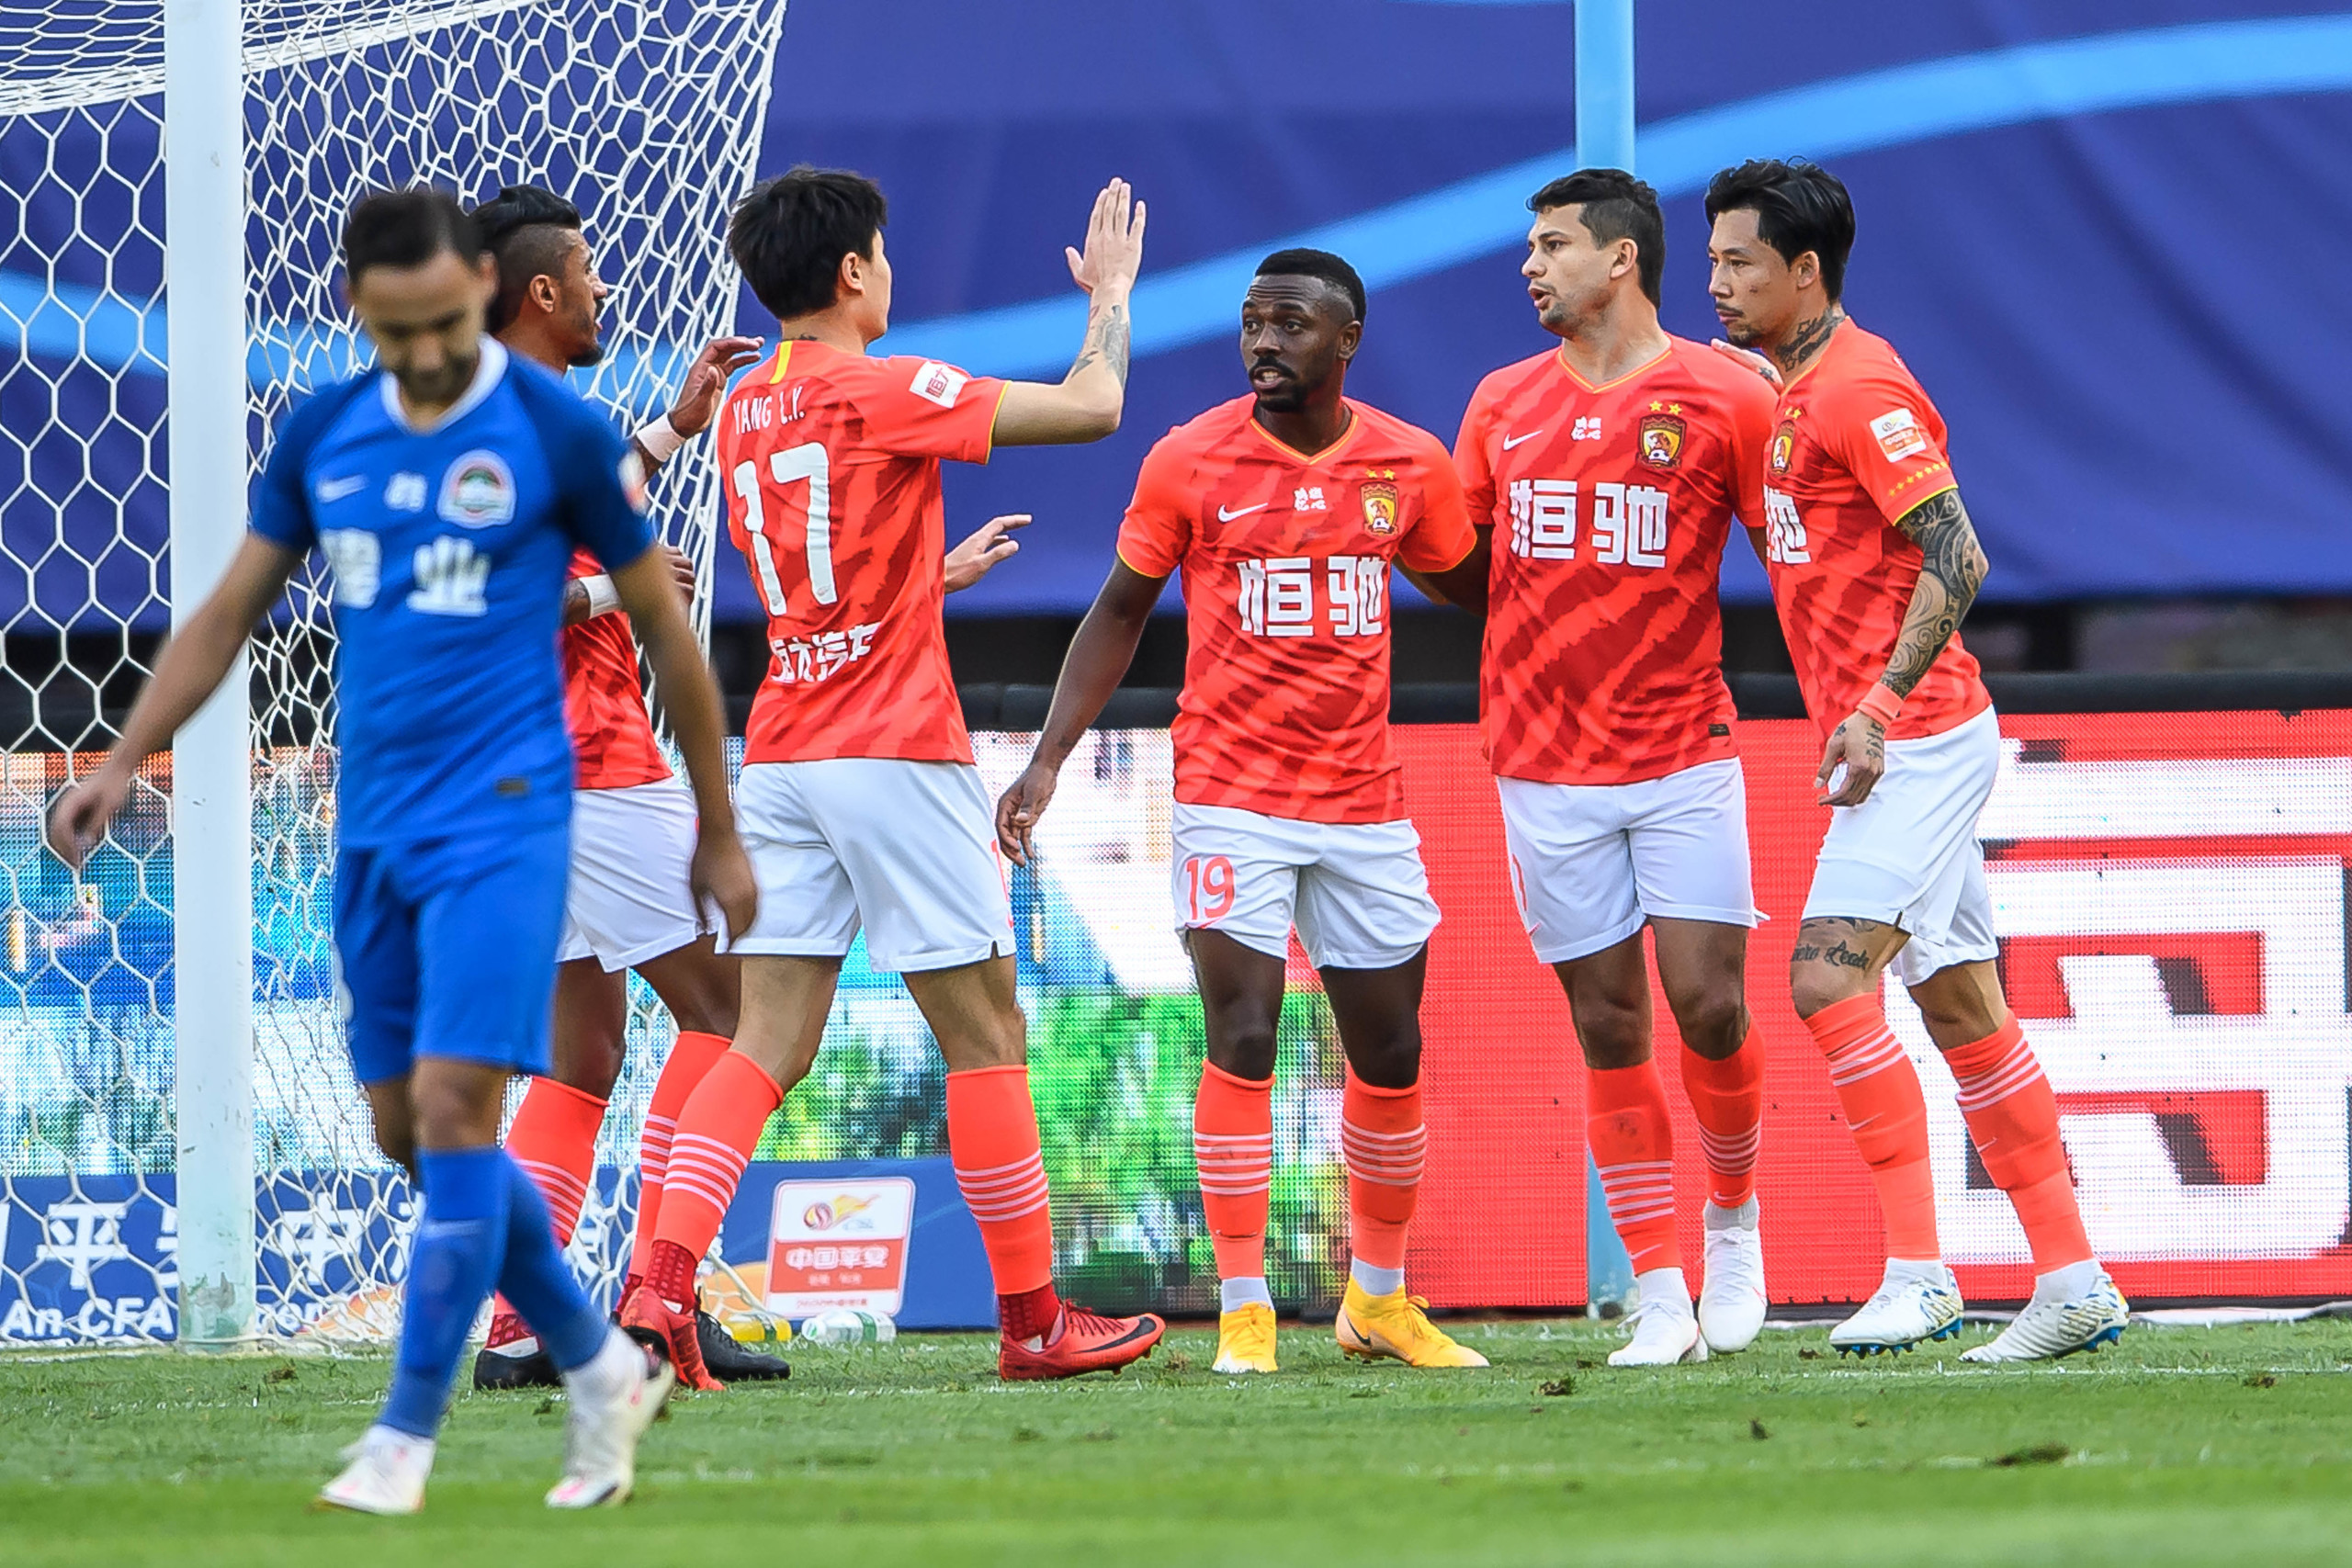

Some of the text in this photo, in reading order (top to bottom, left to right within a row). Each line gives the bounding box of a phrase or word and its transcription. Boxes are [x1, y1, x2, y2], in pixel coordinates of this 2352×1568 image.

[732, 385, 805, 436] YANG L.Y.
[733, 441, 838, 616] 17
[1509, 479, 1669, 569] 恒驰
[1236, 555, 1387, 637] 恒驰
[1186, 855, 1236, 920] 19
[2, 1298, 64, 1337] An
[79, 1296, 175, 1336] CFA
